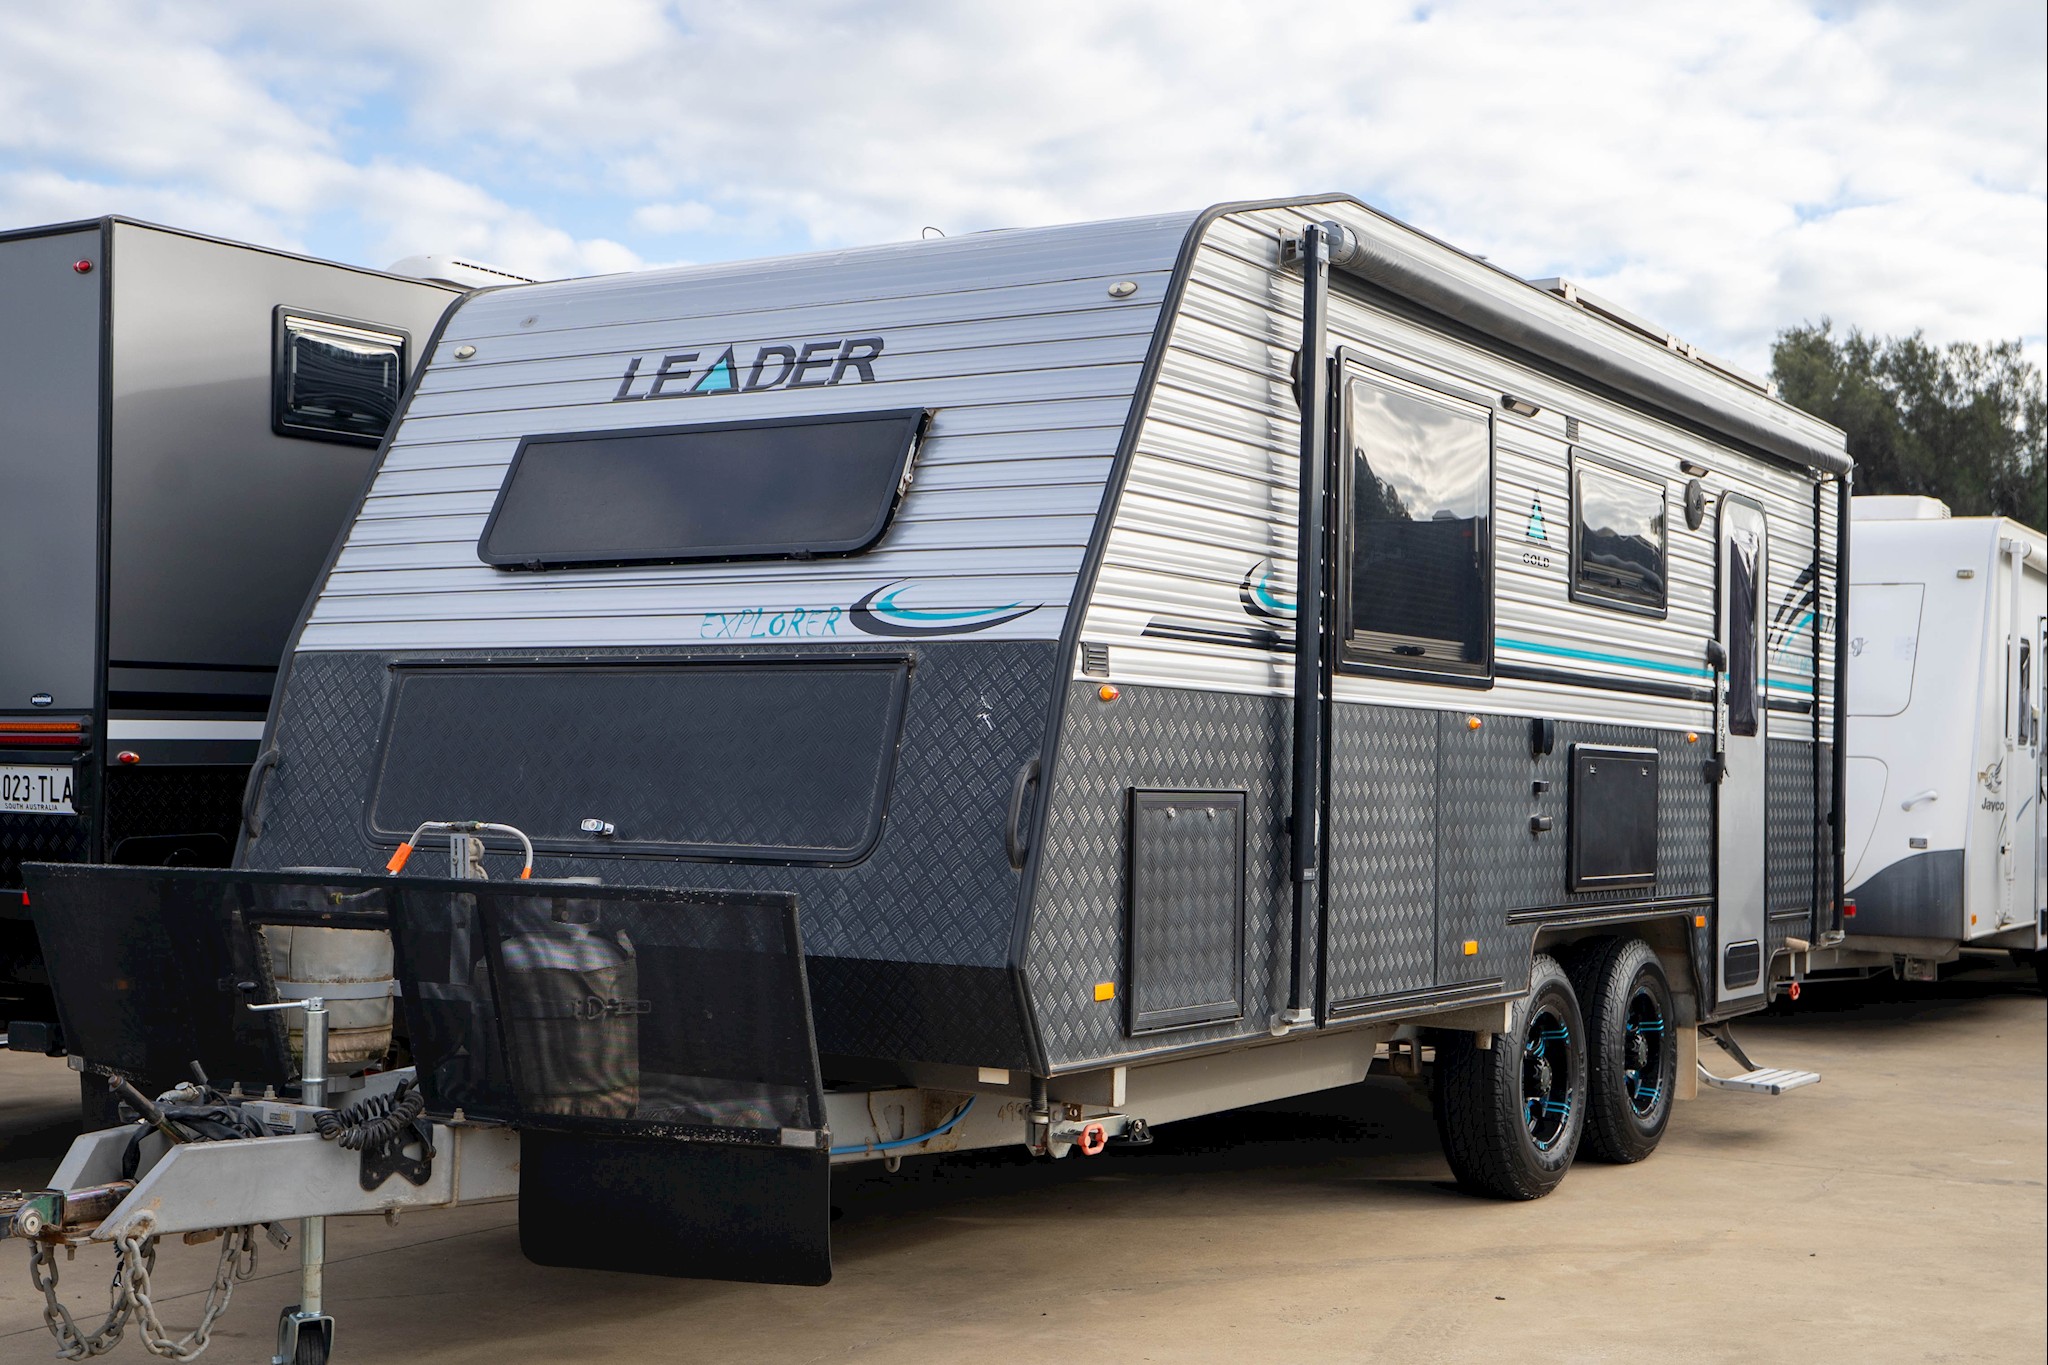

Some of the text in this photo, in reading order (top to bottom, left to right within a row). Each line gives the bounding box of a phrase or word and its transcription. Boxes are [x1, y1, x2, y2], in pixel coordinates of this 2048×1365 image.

[612, 336, 884, 401] LEADER
[700, 606, 842, 639] EXPLORER
[1981, 797, 2005, 812] Jayco
